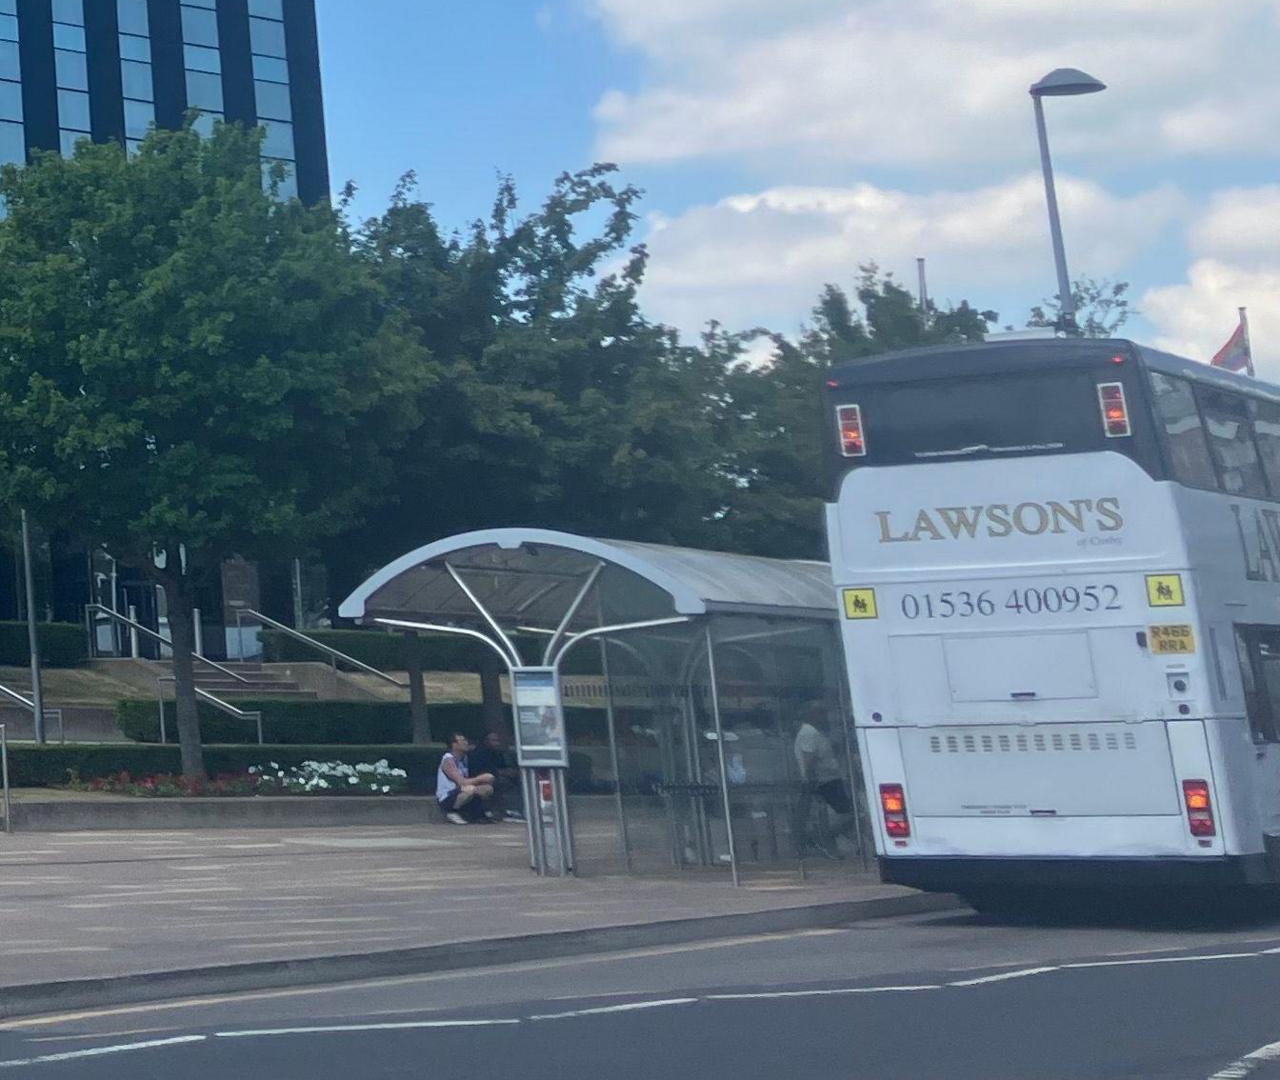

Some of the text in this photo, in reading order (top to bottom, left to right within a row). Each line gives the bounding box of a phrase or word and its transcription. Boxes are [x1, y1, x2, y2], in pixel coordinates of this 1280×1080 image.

[874, 497, 1124, 544] LAWSON'S
[1228, 503, 1280, 582] LA
[901, 584, 1122, 619] 01536 400952
